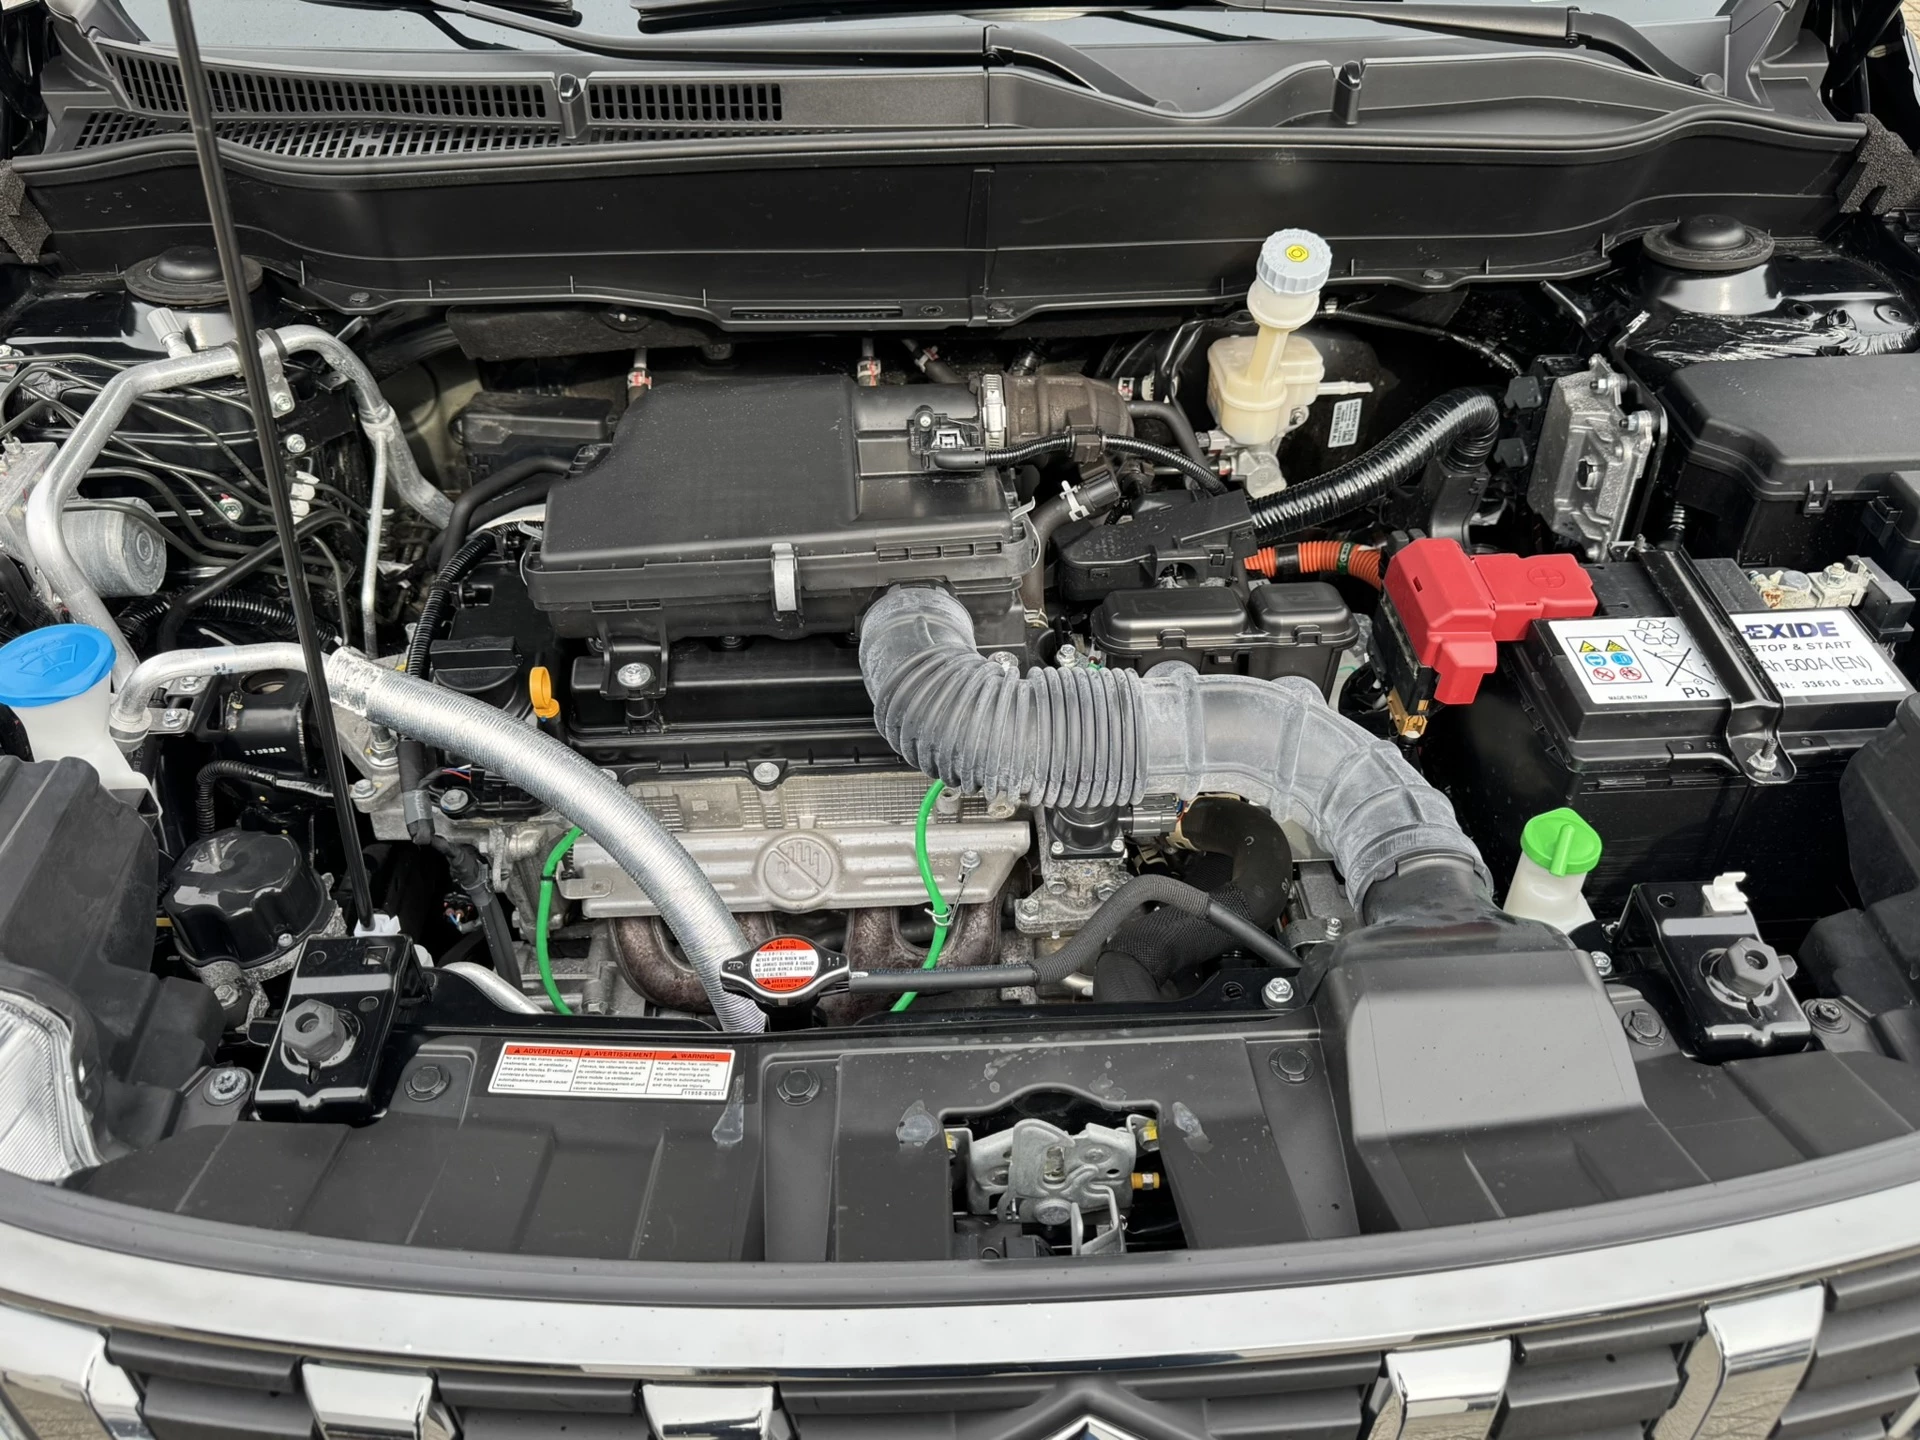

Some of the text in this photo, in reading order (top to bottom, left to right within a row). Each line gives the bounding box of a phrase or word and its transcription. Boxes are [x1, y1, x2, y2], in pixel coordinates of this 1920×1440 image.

[1742, 622, 1840, 640] EXIDE
[1750, 643, 1787, 652] STOP
[1806, 641, 1852, 650] START
[1802, 680, 1840, 688] 33610
[1682, 686, 1710, 699] Pb
[828, 956, 839, 966] 1.1
